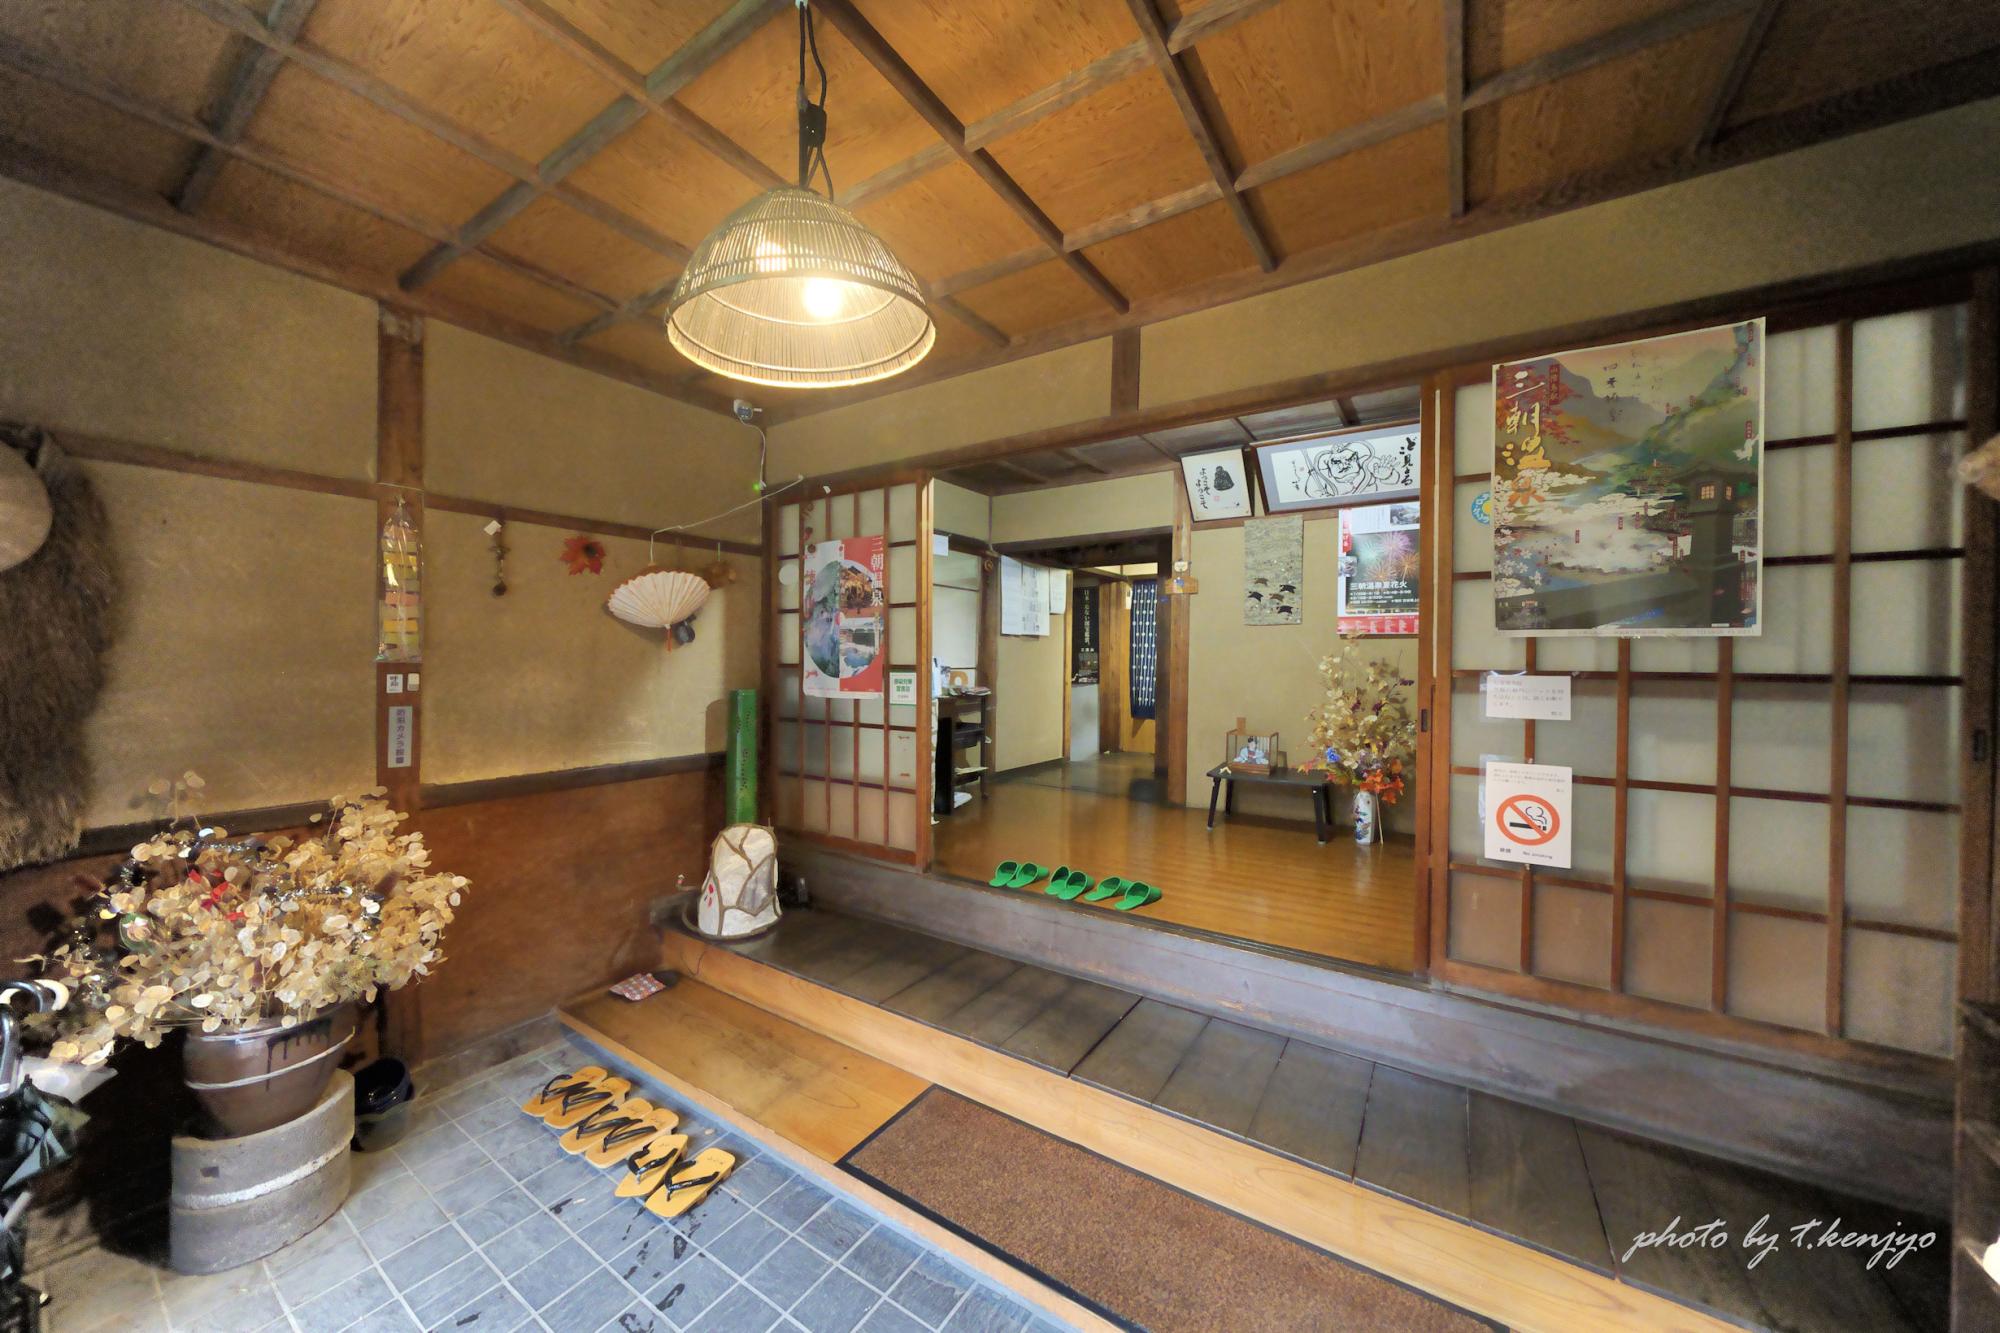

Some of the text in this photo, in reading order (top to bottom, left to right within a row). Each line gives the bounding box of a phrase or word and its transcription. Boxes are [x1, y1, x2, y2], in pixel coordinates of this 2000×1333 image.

[1501, 370, 1552, 506] 三朝温泉
[870, 536, 884, 607] 三朝温泉
